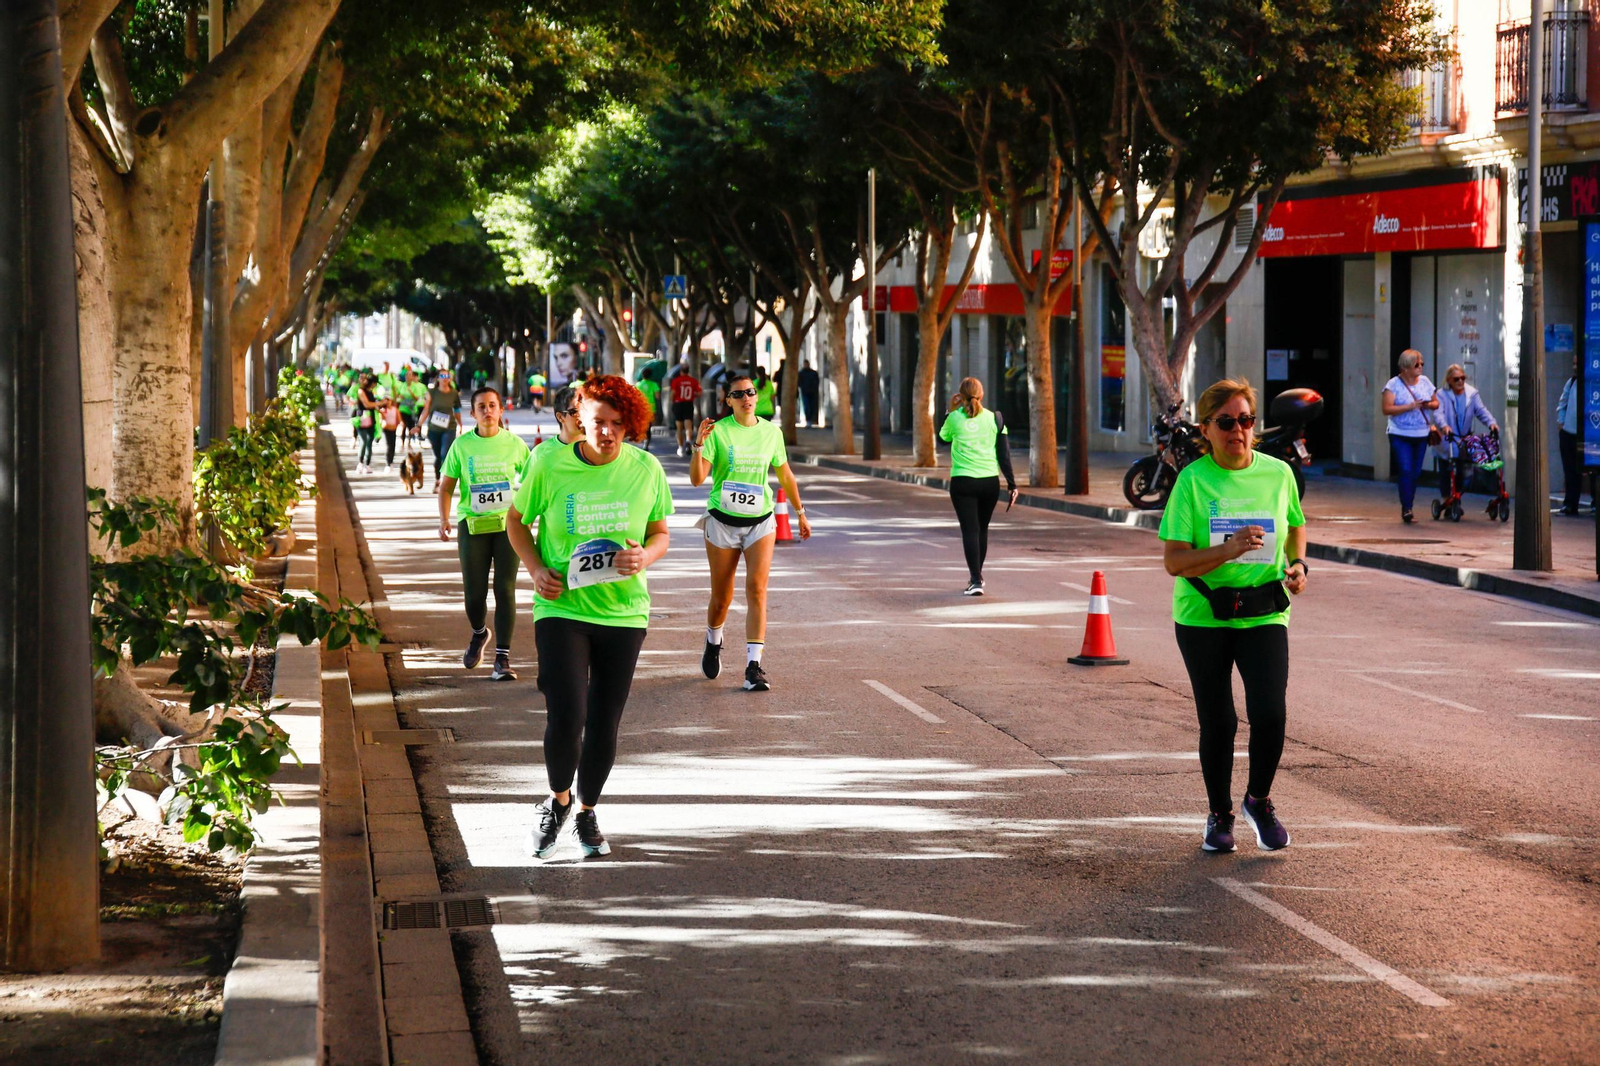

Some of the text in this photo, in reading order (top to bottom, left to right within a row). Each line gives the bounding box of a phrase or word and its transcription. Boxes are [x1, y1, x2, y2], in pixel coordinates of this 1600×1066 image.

[1373, 213, 1400, 234] Adecco
[1262, 224, 1285, 242] Adecco
[680, 385, 693, 400] 10
[478, 491, 503, 504] 841
[730, 492, 756, 506] 192
[576, 500, 629, 513] En marcha
[1220, 509, 1271, 518] En marcha
[565, 493, 575, 536] ALMERÍA
[576, 508, 629, 522] contra el
[577, 521, 630, 536] cáncer
[579, 551, 617, 573] 287
